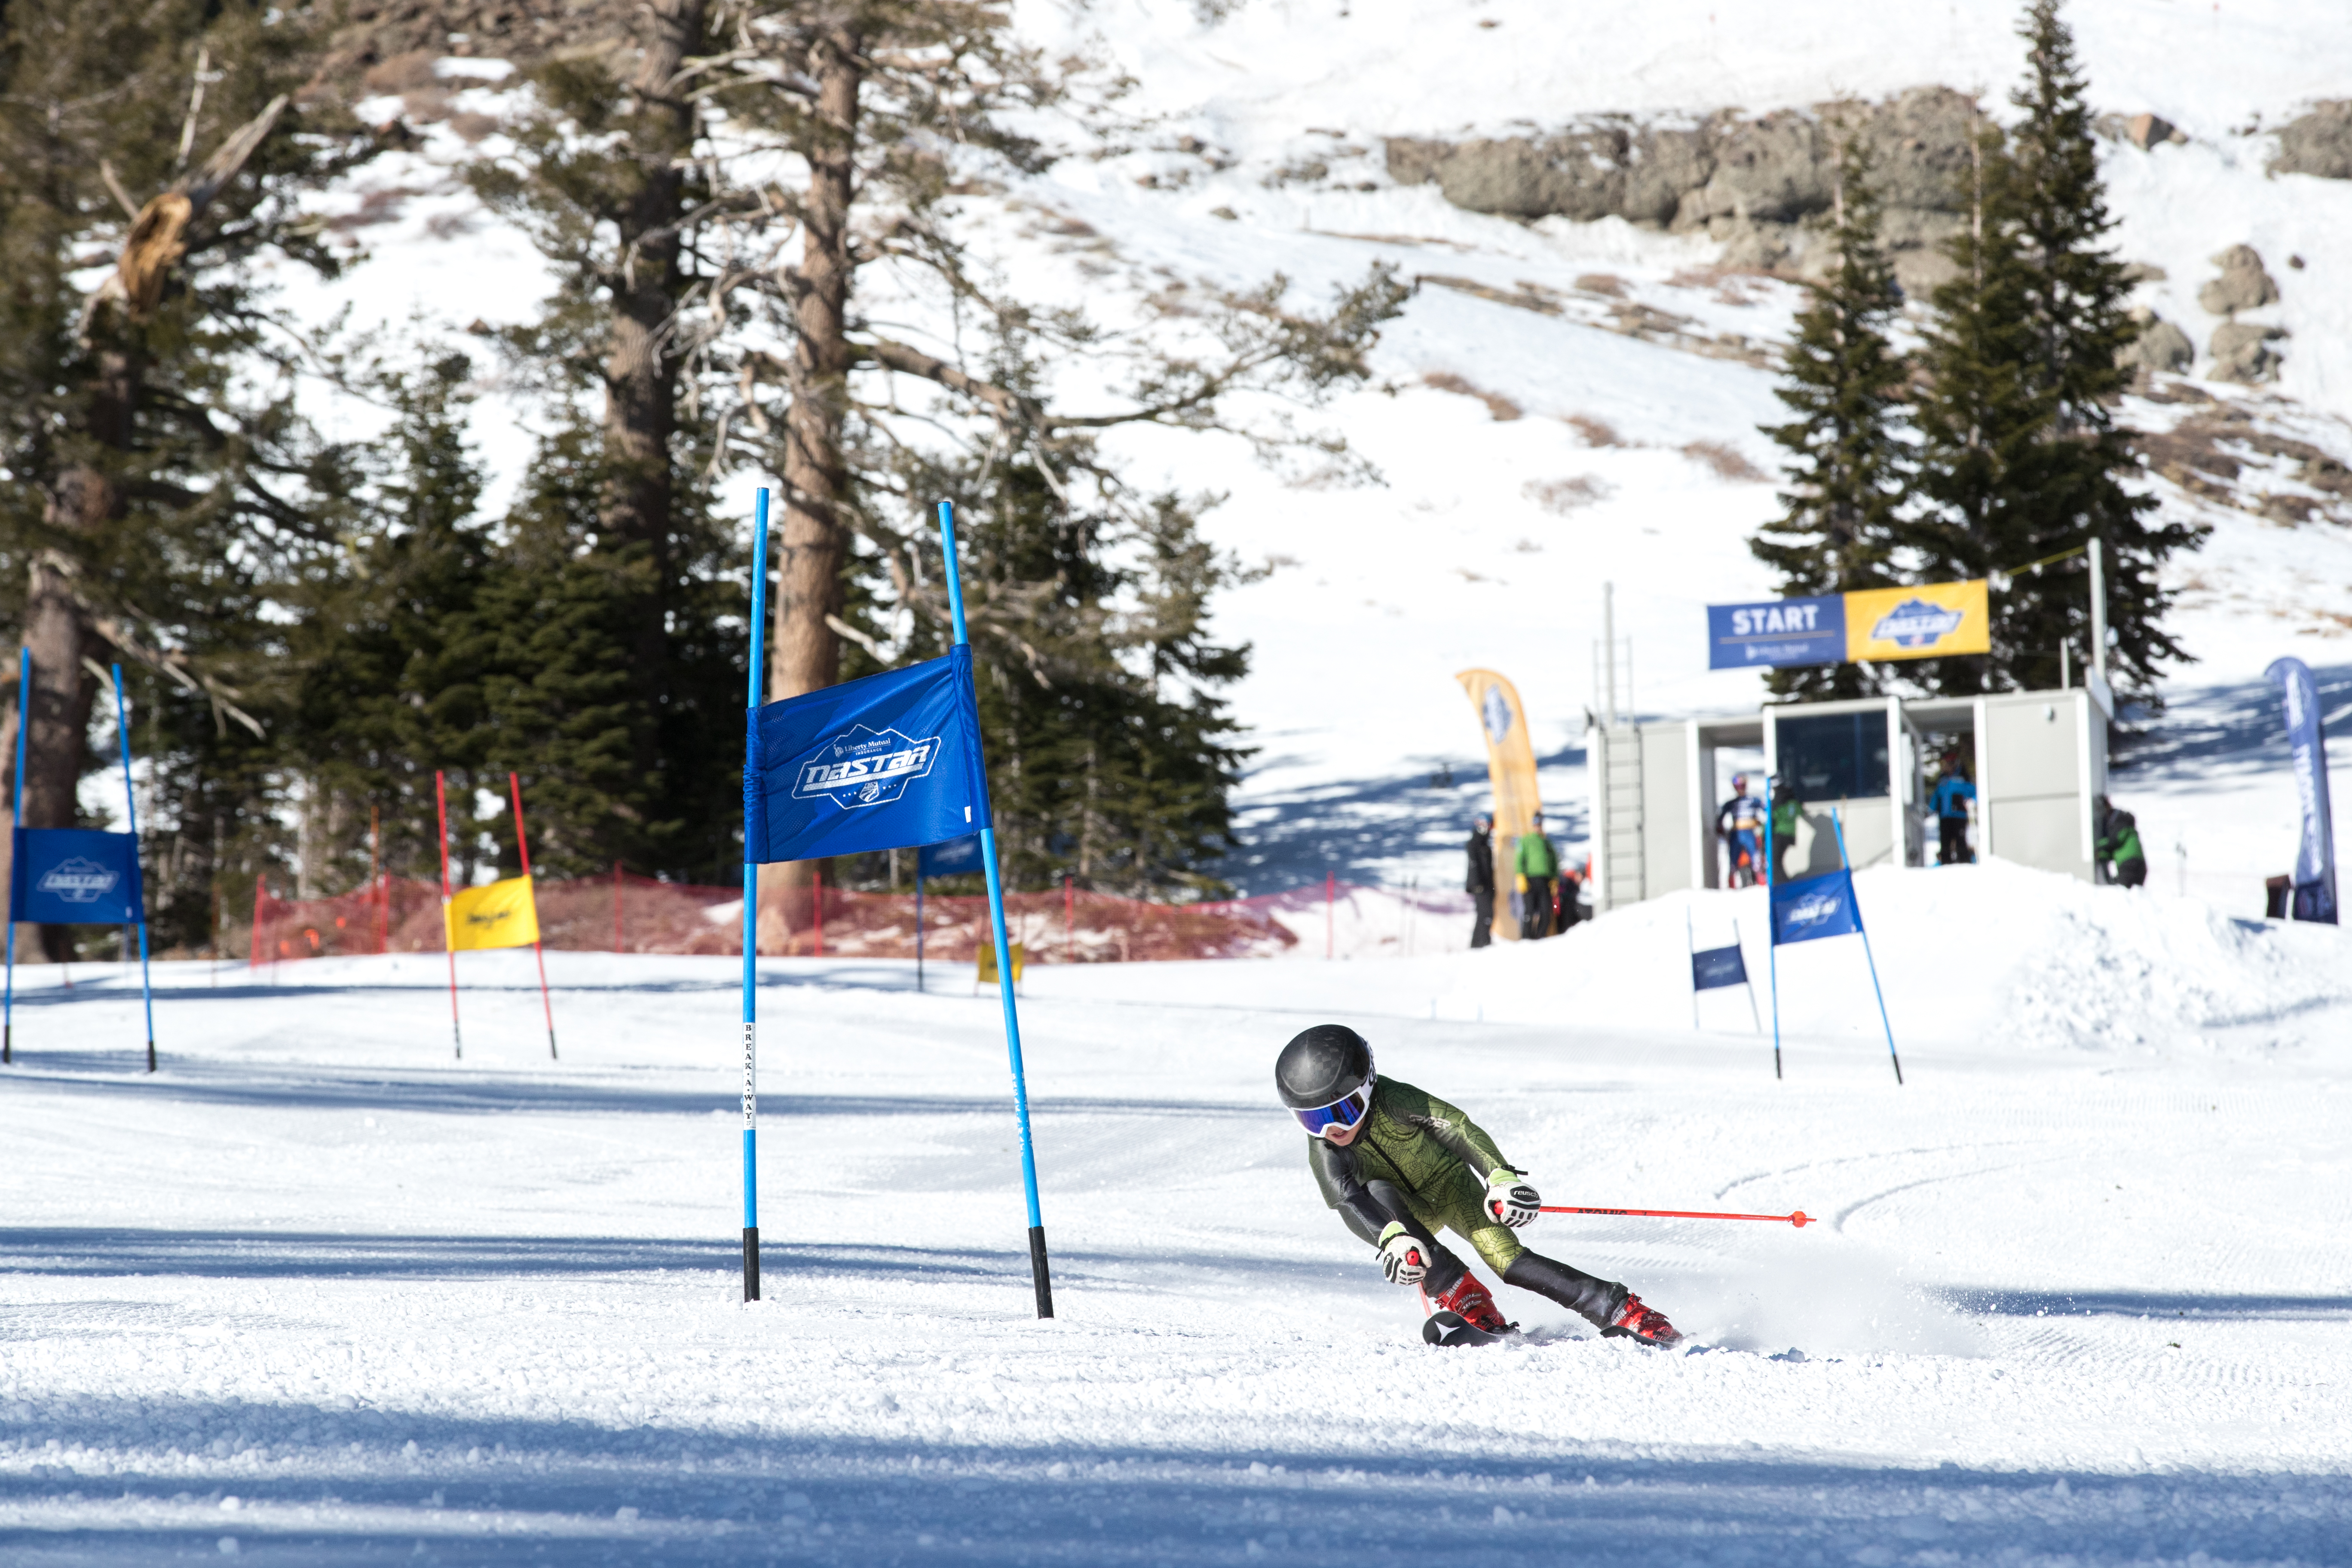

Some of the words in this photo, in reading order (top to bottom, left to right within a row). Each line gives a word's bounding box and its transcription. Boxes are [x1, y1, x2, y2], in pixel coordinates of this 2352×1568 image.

[1731, 604, 1819, 635] START
[845, 744, 867, 752] Liberty
[867, 738, 891, 747] Mutual
[855, 747, 882, 756] INSURANCE
[1409, 1115, 1451, 1130] SPYDER
